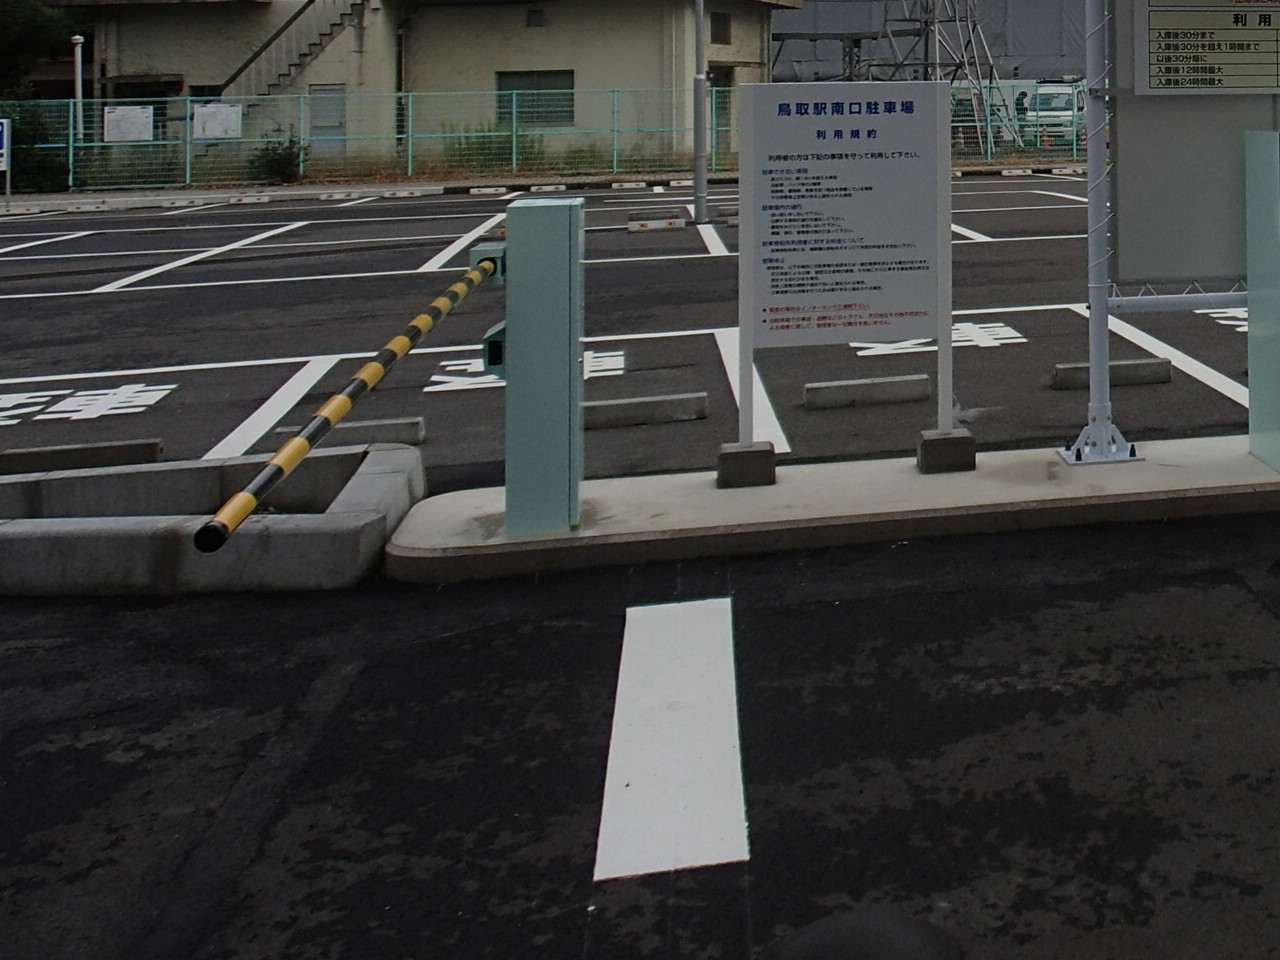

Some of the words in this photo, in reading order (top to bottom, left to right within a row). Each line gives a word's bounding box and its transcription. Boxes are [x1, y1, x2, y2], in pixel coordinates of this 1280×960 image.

[1156, 31, 1215, 40] 入庫後30分まで
[1156, 65, 1223, 75] 入庫後12時間最大
[1156, 76, 1223, 86] 入庫後24時間最大
[777, 100, 915, 117] 鳥取駅南口駐車場
[816, 129, 877, 140] 利用規約
